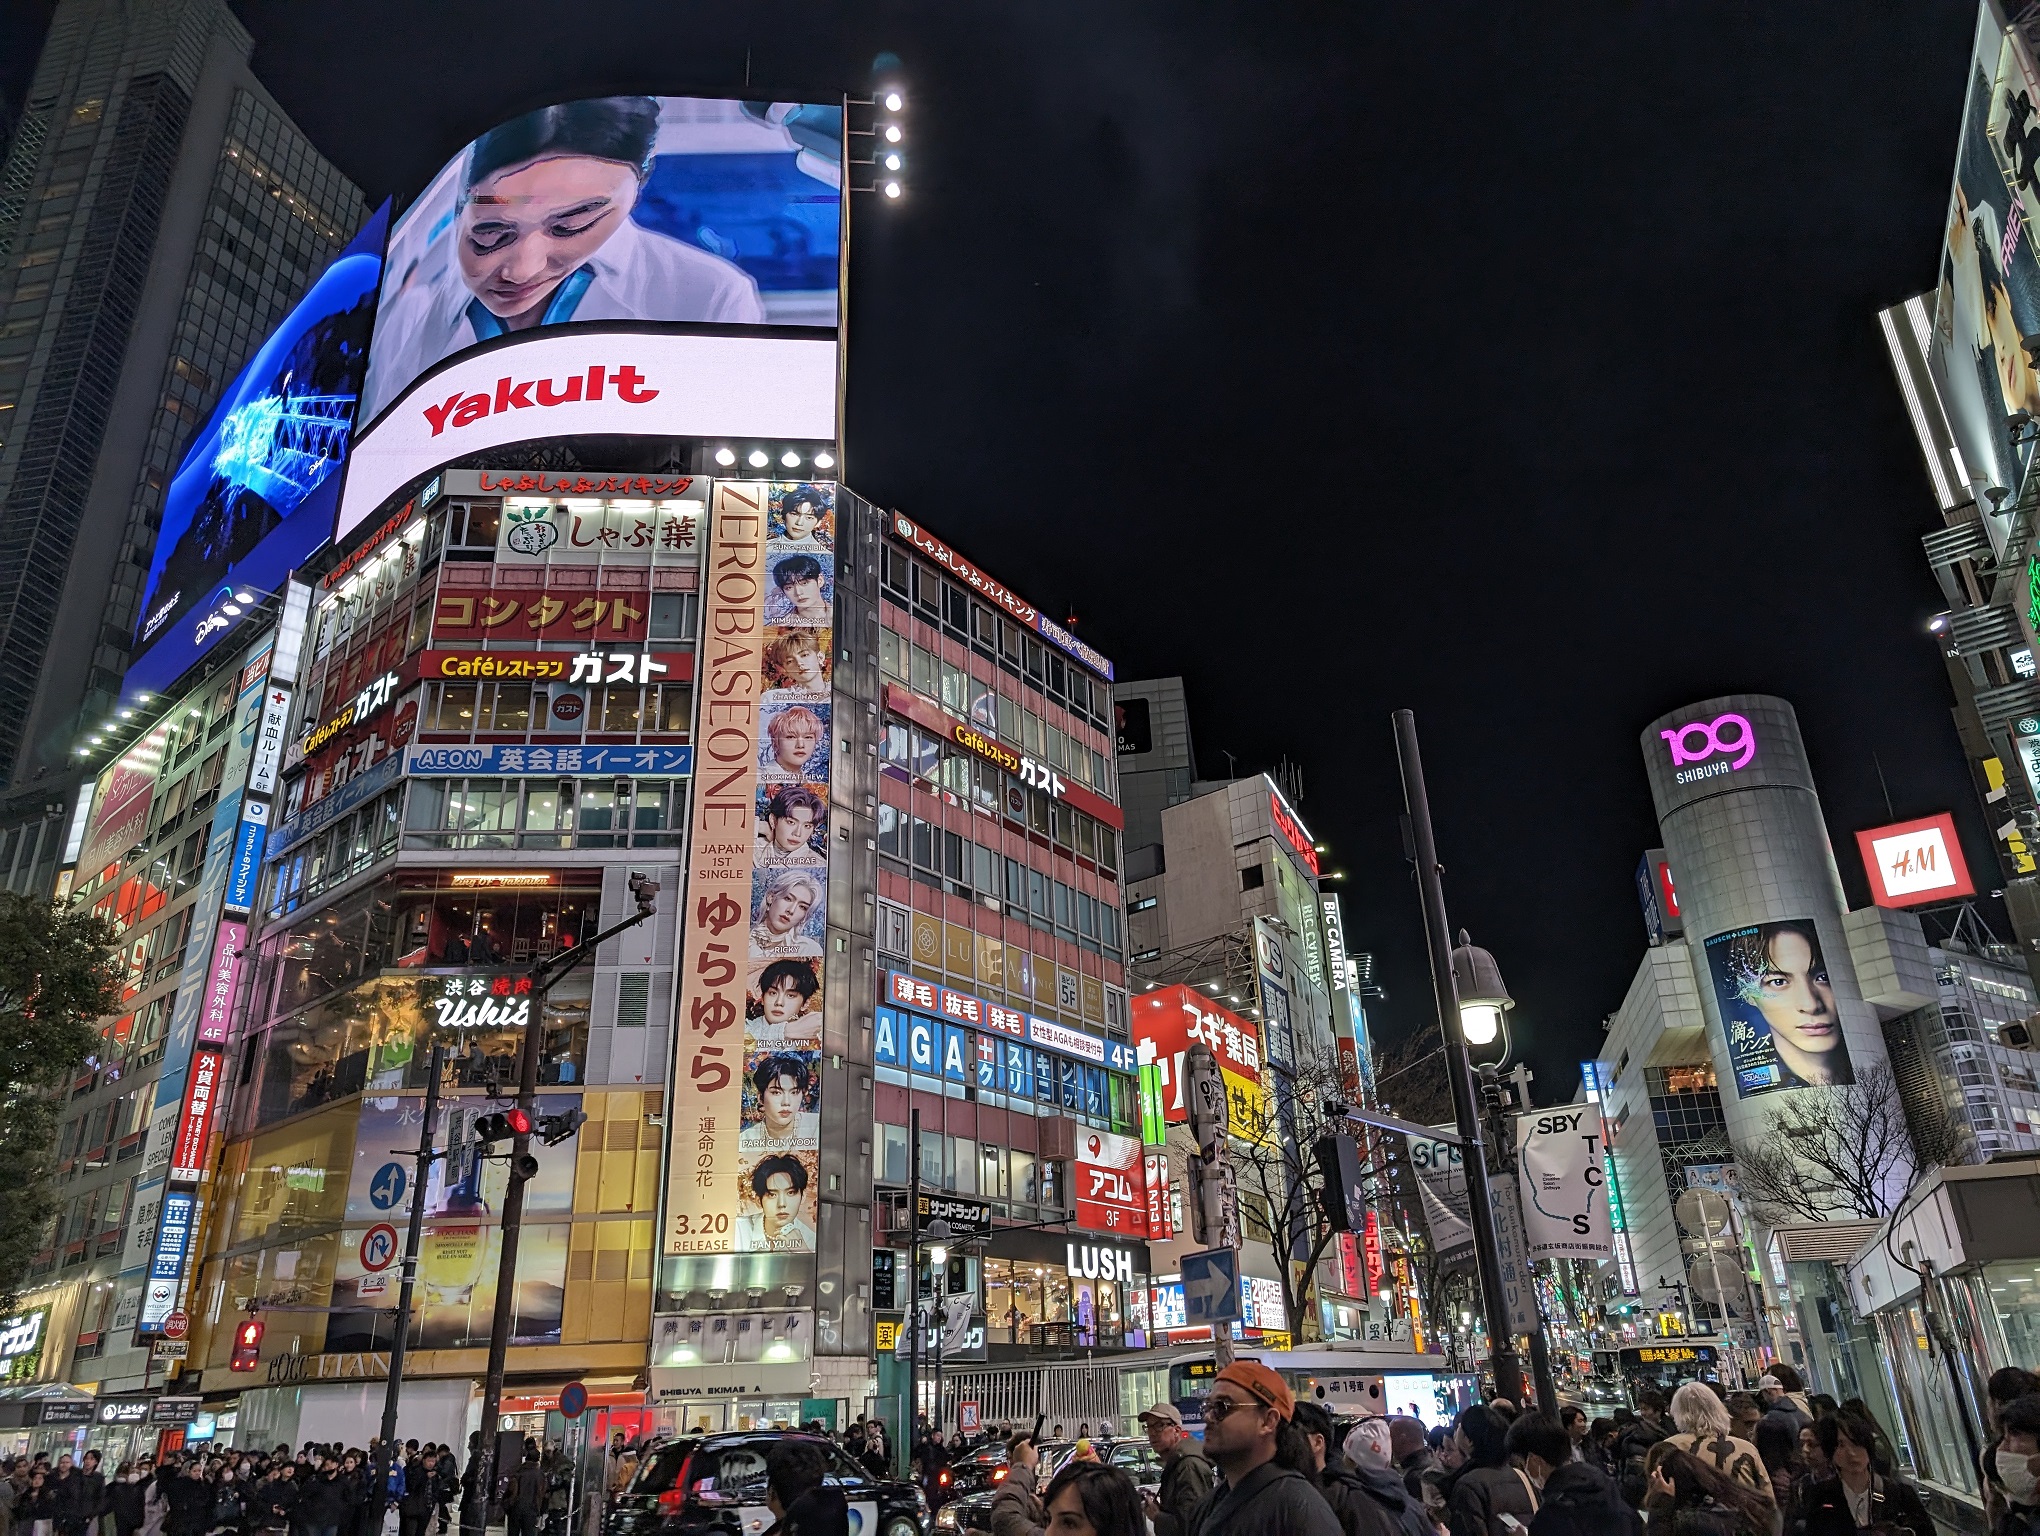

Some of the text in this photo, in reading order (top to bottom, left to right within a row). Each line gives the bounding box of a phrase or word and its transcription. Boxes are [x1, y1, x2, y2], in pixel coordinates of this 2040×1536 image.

[423, 366, 659, 437] Yakult
[480, 472, 693, 495] しゃぶしゃぶバイキング
[324, 499, 415, 588] しゃぶしゃぶバイキング
[571, 515, 696, 550] しゃぶ葉
[914, 525, 1037, 623] しゃぶしゃぶバイキング
[437, 597, 645, 630] コンタクト
[441, 652, 668, 684] Caféレストラン ガスト
[702, 485, 760, 831] ZEROBASEONE
[2022, 669, 2036, 677] 7F
[303, 671, 398, 755] Caféレストラン ガスト
[556, 704, 580, 713] ガスト
[257, 713, 282, 780] 献血ルーム
[1661, 714, 1755, 769] 109
[331, 733, 387, 789] ガスト
[421, 748, 685, 771] AEON 英会話イーオン
[955, 725, 1066, 798] Caféレストラン ガスト
[1676, 762, 1729, 784] SHIBUYA
[255, 781, 268, 791] 6F
[701, 844, 745, 854] JAPAN
[712, 857, 731, 867] 1ST
[1891, 845, 1936, 878] H&M
[699, 869, 744, 879] SINGLE
[1323, 901, 1345, 991] BIC CAMERA
[1706, 927, 1759, 947] BAUSCH LOMB
[209, 943, 235, 1023] 品川美容外科
[691, 892, 742, 1093] ゆらゆら
[1062, 985, 1076, 1006] 5F
[204, 1027, 223, 1040] 4F
[897, 977, 1134, 1071] 薄毛 抜毛 発毛 女性型AGAも相談受付中 4F
[1731, 1022, 1756, 1046] 滴る
[757, 1039, 810, 1048] KIM GYU VIN
[876, 1017, 963, 1073] AGA
[1182, 1003, 1260, 1073] スギ薬局
[1740, 1033, 1772, 1053] レンズ
[1009, 1046, 1074, 1081] スキン
[190, 1055, 216, 1117] 外貨両替
[979, 1066, 1100, 1113] クリニック
[1537, 1112, 1583, 1134] SBY
[696, 1117, 716, 1188] 運命の花
[742, 1138, 816, 1147] PARK GUN WOOK
[1582, 1135, 1599, 1154] T
[177, 1169, 194, 1178] 7F
[1584, 1167, 1603, 1187] C
[1089, 1169, 1133, 1203] アコム
[919, 1198, 980, 1221] 薬 サンドラッグ
[1149, 1190, 1160, 1223] アコム
[1162, 1190, 1171, 1222] アコム
[675, 1212, 729, 1235] 3.20
[951, 1222, 976, 1232] COSMETIC
[1106, 1210, 1120, 1227] 3F
[1573, 1214, 1591, 1235] S
[673, 1239, 729, 1252] RELEASE
[751, 1239, 802, 1248] HAN YU JIN
[1067, 1243, 1132, 1282] LUSH
[1159, 1287, 1177, 1313] 24
[664, 1319, 800, 1334] 渋谷駅前ビル
[878, 1326, 892, 1346] 薬
[660, 1386, 702, 1396] SHIBUYA
[708, 1386, 746, 1395] EKIMAE
[1342, 1380, 1365, 1393] 1号車
[533, 1399, 556, 1411] ploom
